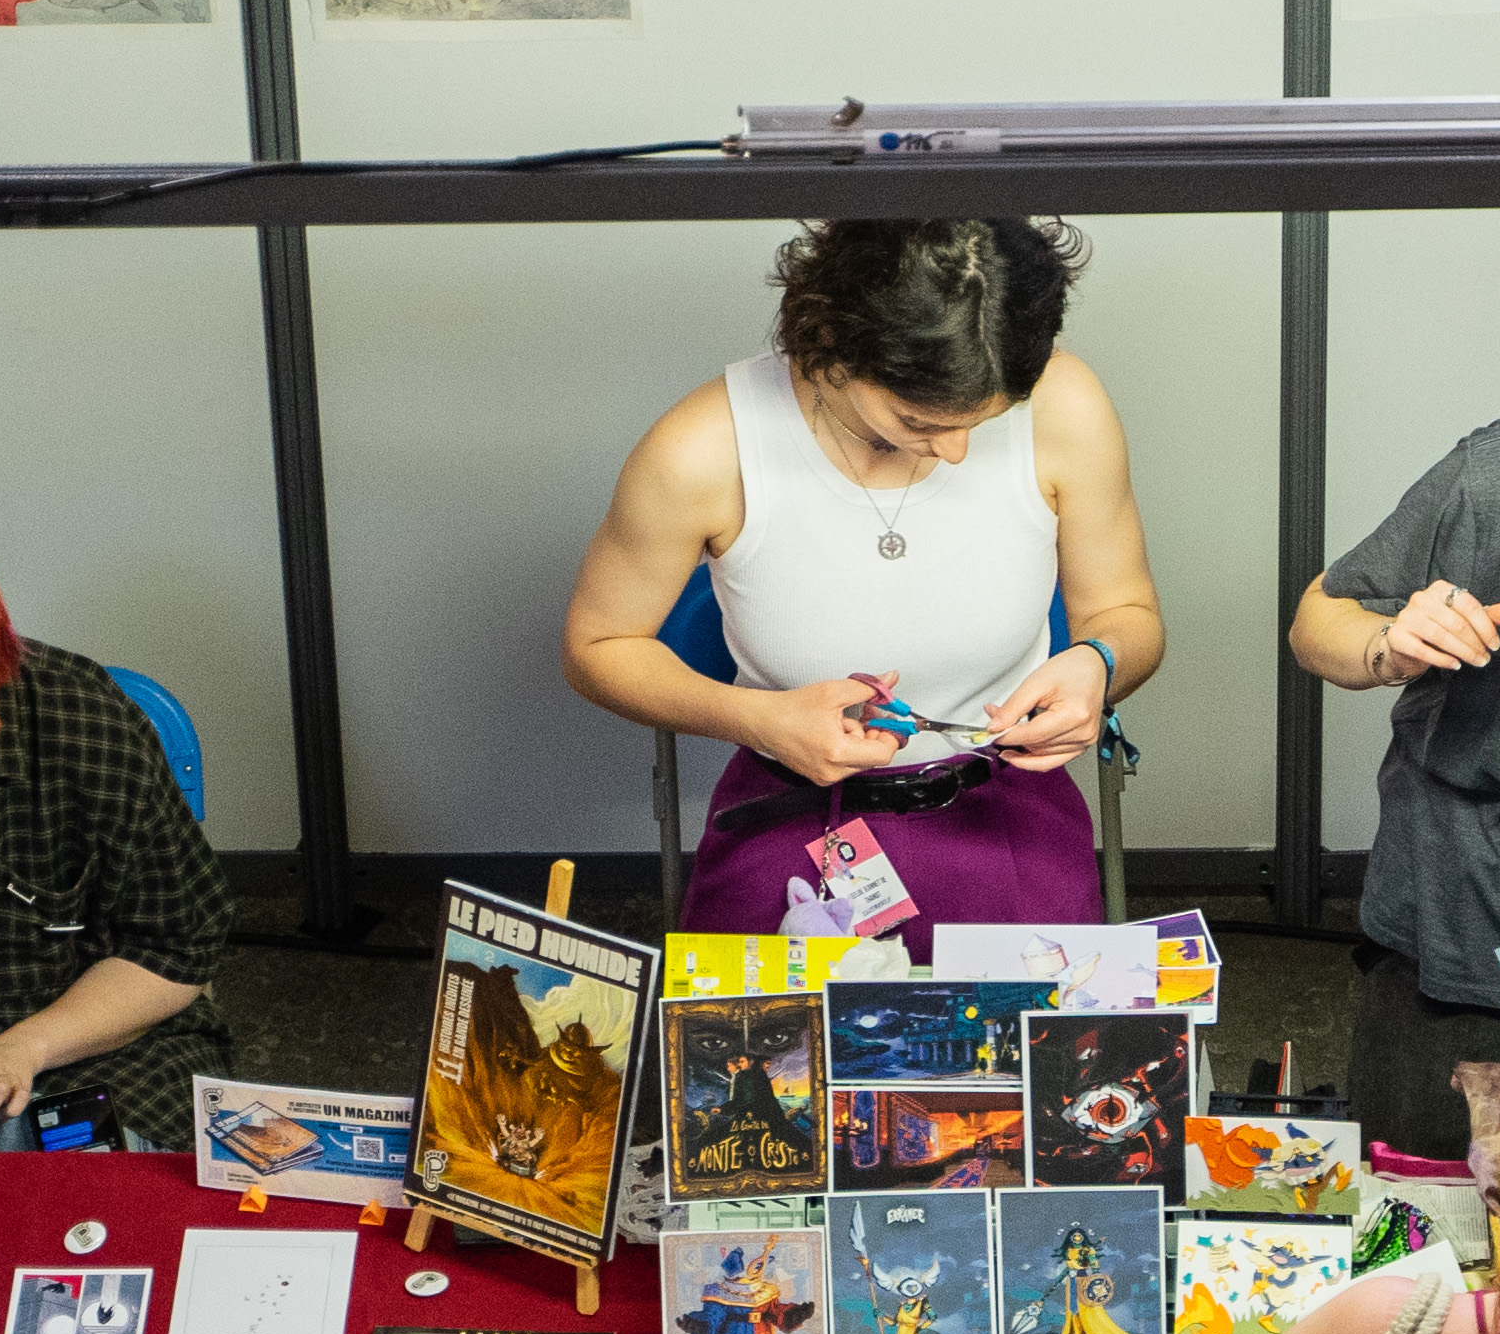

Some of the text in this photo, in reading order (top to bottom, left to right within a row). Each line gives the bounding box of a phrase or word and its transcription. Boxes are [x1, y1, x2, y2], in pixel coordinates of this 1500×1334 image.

[448, 895, 477, 932] LE
[476, 906, 538, 953] PIED
[538, 927, 643, 988] HUMIDE
[323, 1103, 342, 1117] UN
[344, 1106, 412, 1123] MAGAZINE
